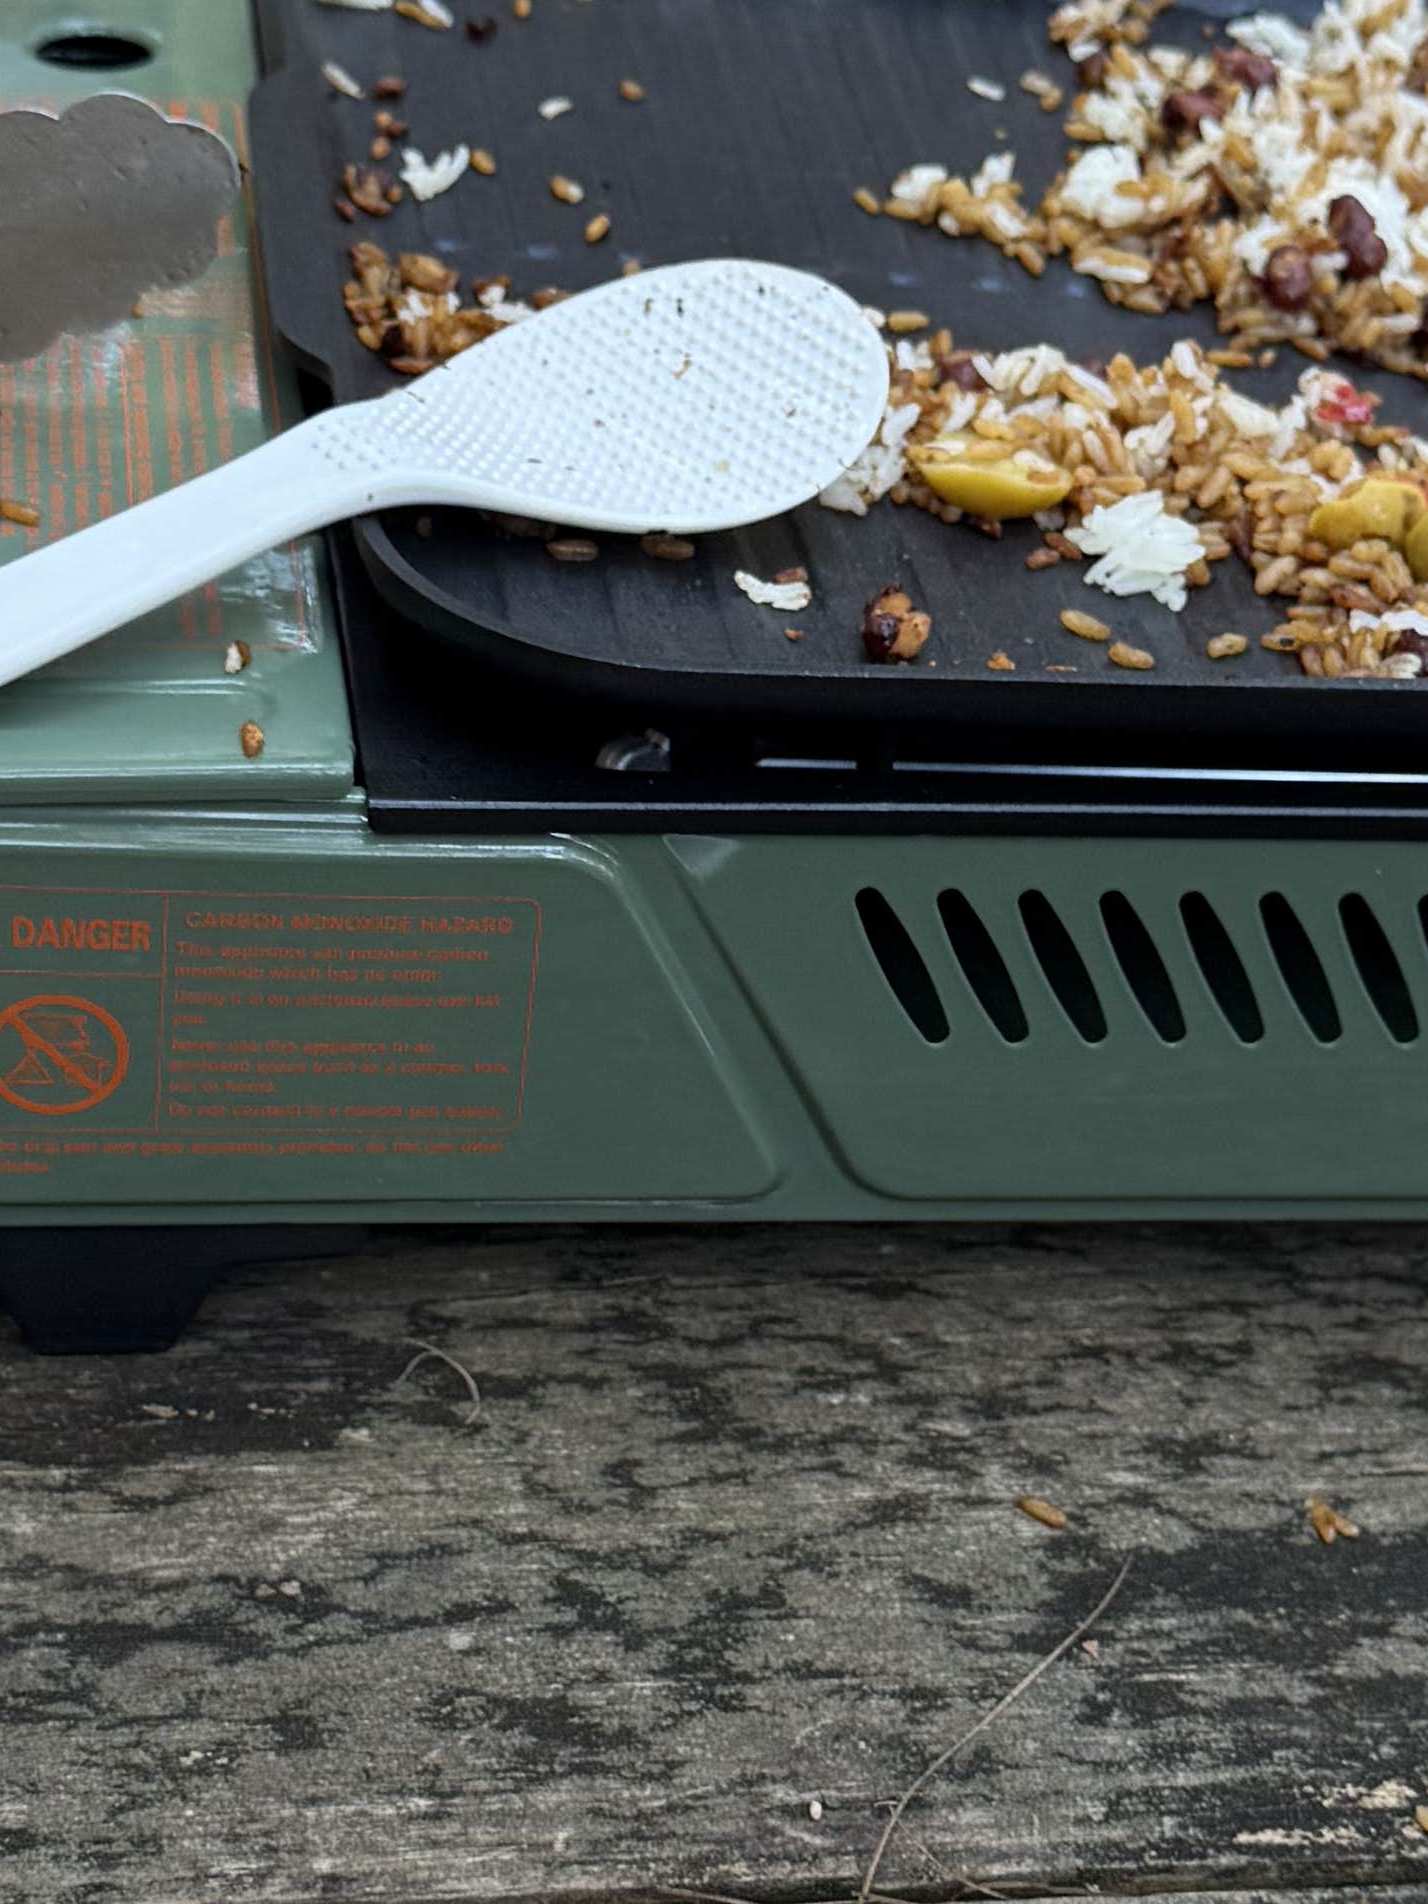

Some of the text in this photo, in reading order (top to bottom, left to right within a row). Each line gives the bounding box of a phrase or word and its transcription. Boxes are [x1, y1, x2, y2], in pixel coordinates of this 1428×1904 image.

[11, 915, 150, 952] DANGER
[185, 912, 284, 929] CARBON
[419, 916, 513, 934] HAZARD
